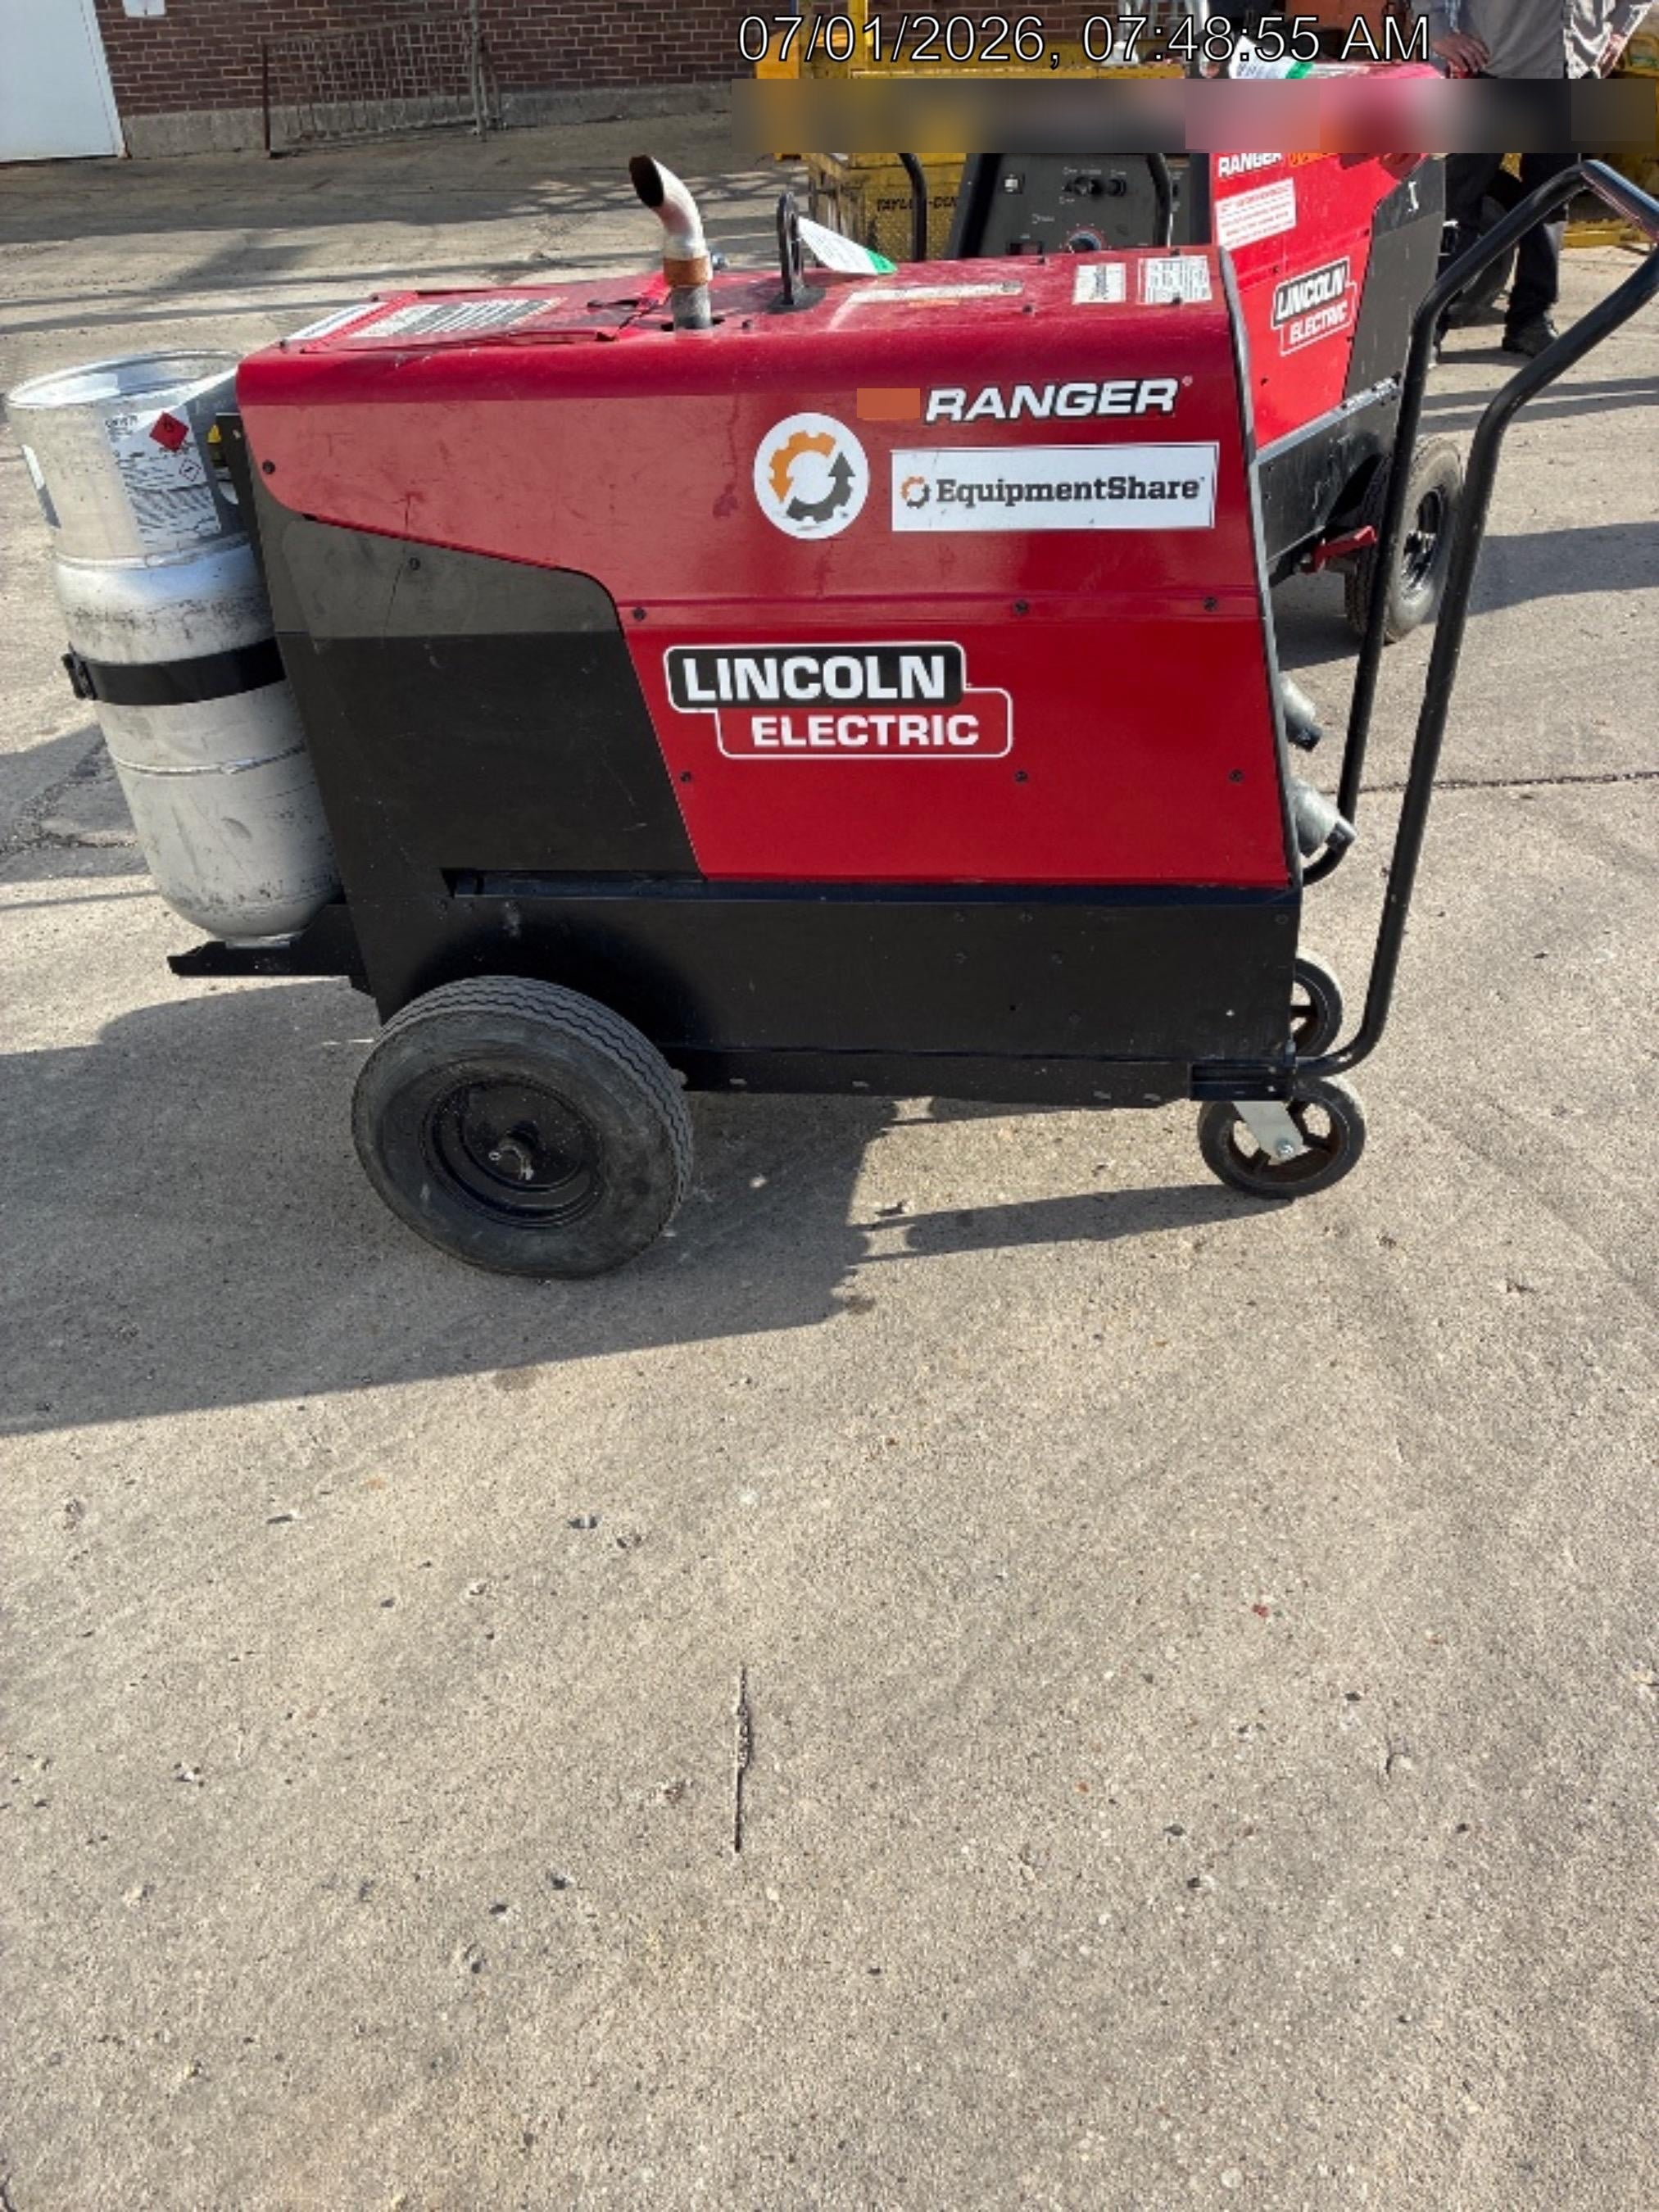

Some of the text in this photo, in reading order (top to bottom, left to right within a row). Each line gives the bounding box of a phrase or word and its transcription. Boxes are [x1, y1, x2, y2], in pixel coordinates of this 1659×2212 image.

[1276, 265, 1347, 321] LINCOLN
[1290, 301, 1349, 345] ELECTRIC
[925, 378, 1178, 424] RANGER
[936, 475, 1200, 507] EquipmentShare
[682, 655, 945, 702] LINCOLN
[750, 714, 980, 747] ELECTRIC
